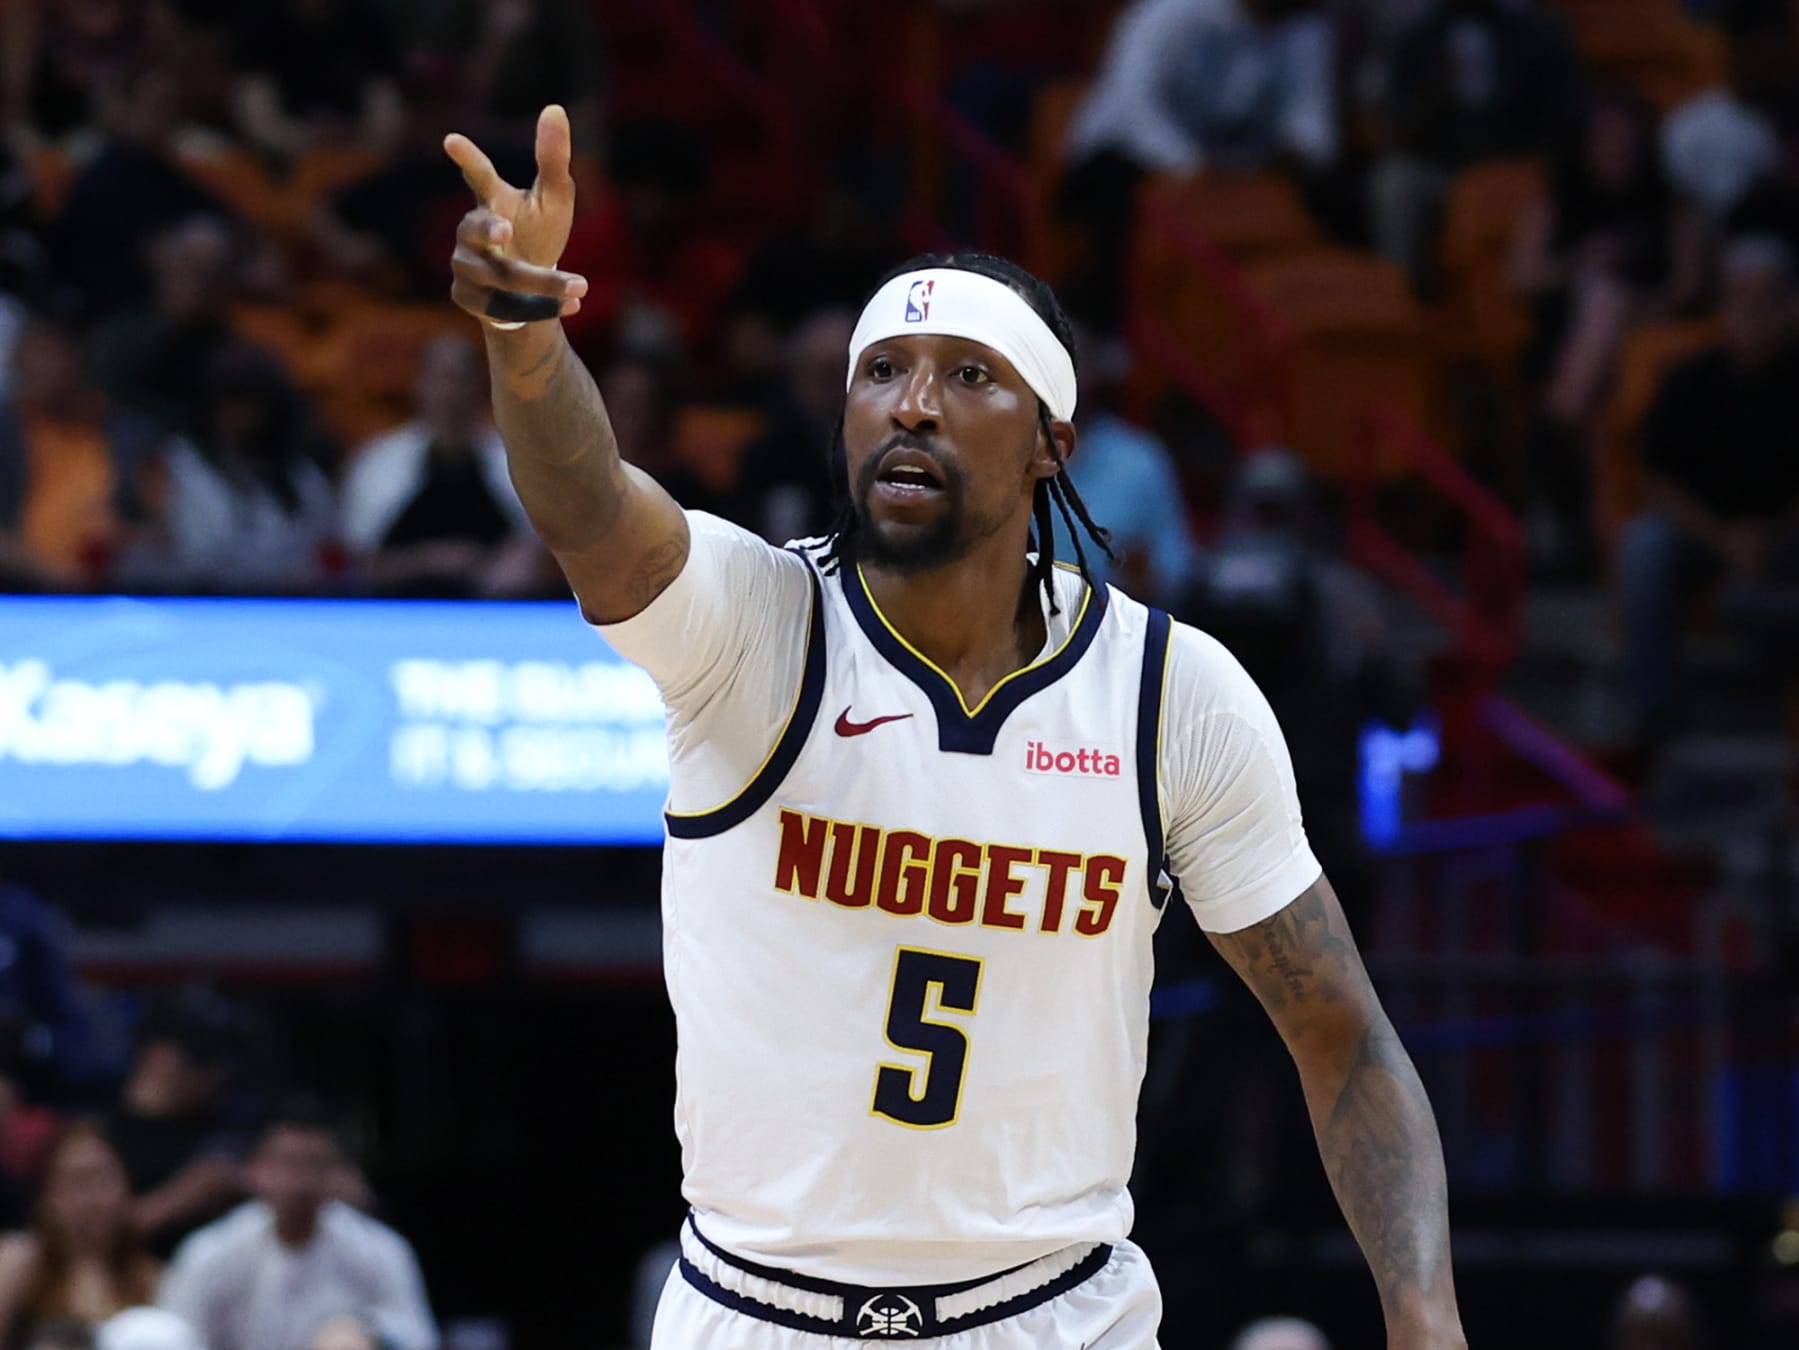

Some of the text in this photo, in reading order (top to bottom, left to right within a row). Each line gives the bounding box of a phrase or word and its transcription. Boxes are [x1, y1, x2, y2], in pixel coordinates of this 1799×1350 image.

[1025, 741, 1120, 776] ibotta
[774, 807, 1128, 938] NUGGETS
[869, 944, 985, 1130] 5
